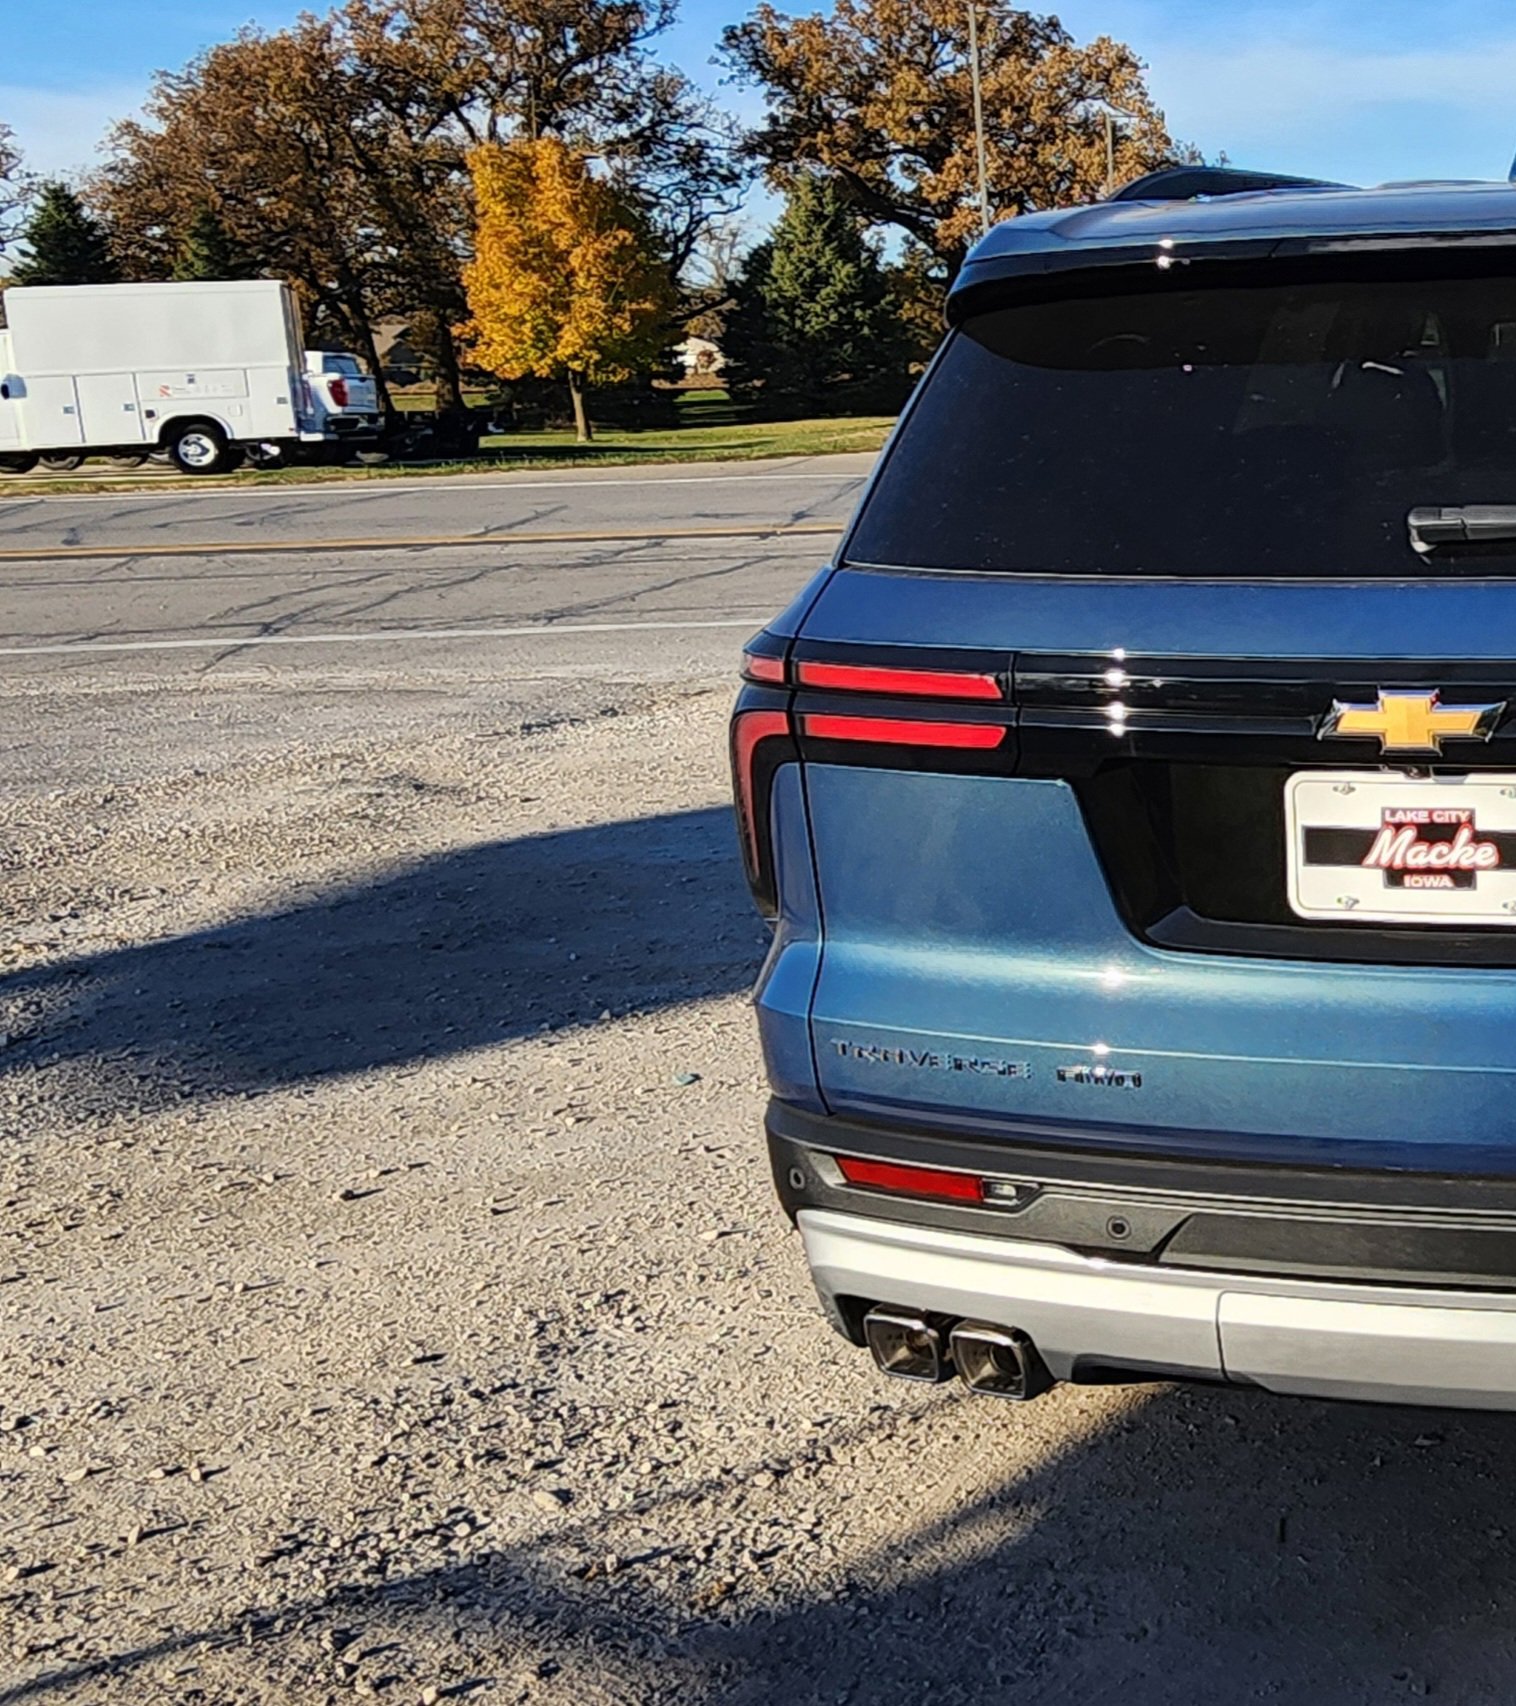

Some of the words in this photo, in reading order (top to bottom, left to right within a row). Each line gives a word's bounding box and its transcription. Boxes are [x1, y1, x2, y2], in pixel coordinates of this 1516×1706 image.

[1384, 810, 1430, 823] LAKE
[1432, 811, 1471, 823] CITY
[1362, 822, 1500, 869] Macke
[1403, 874, 1455, 888] IOWA
